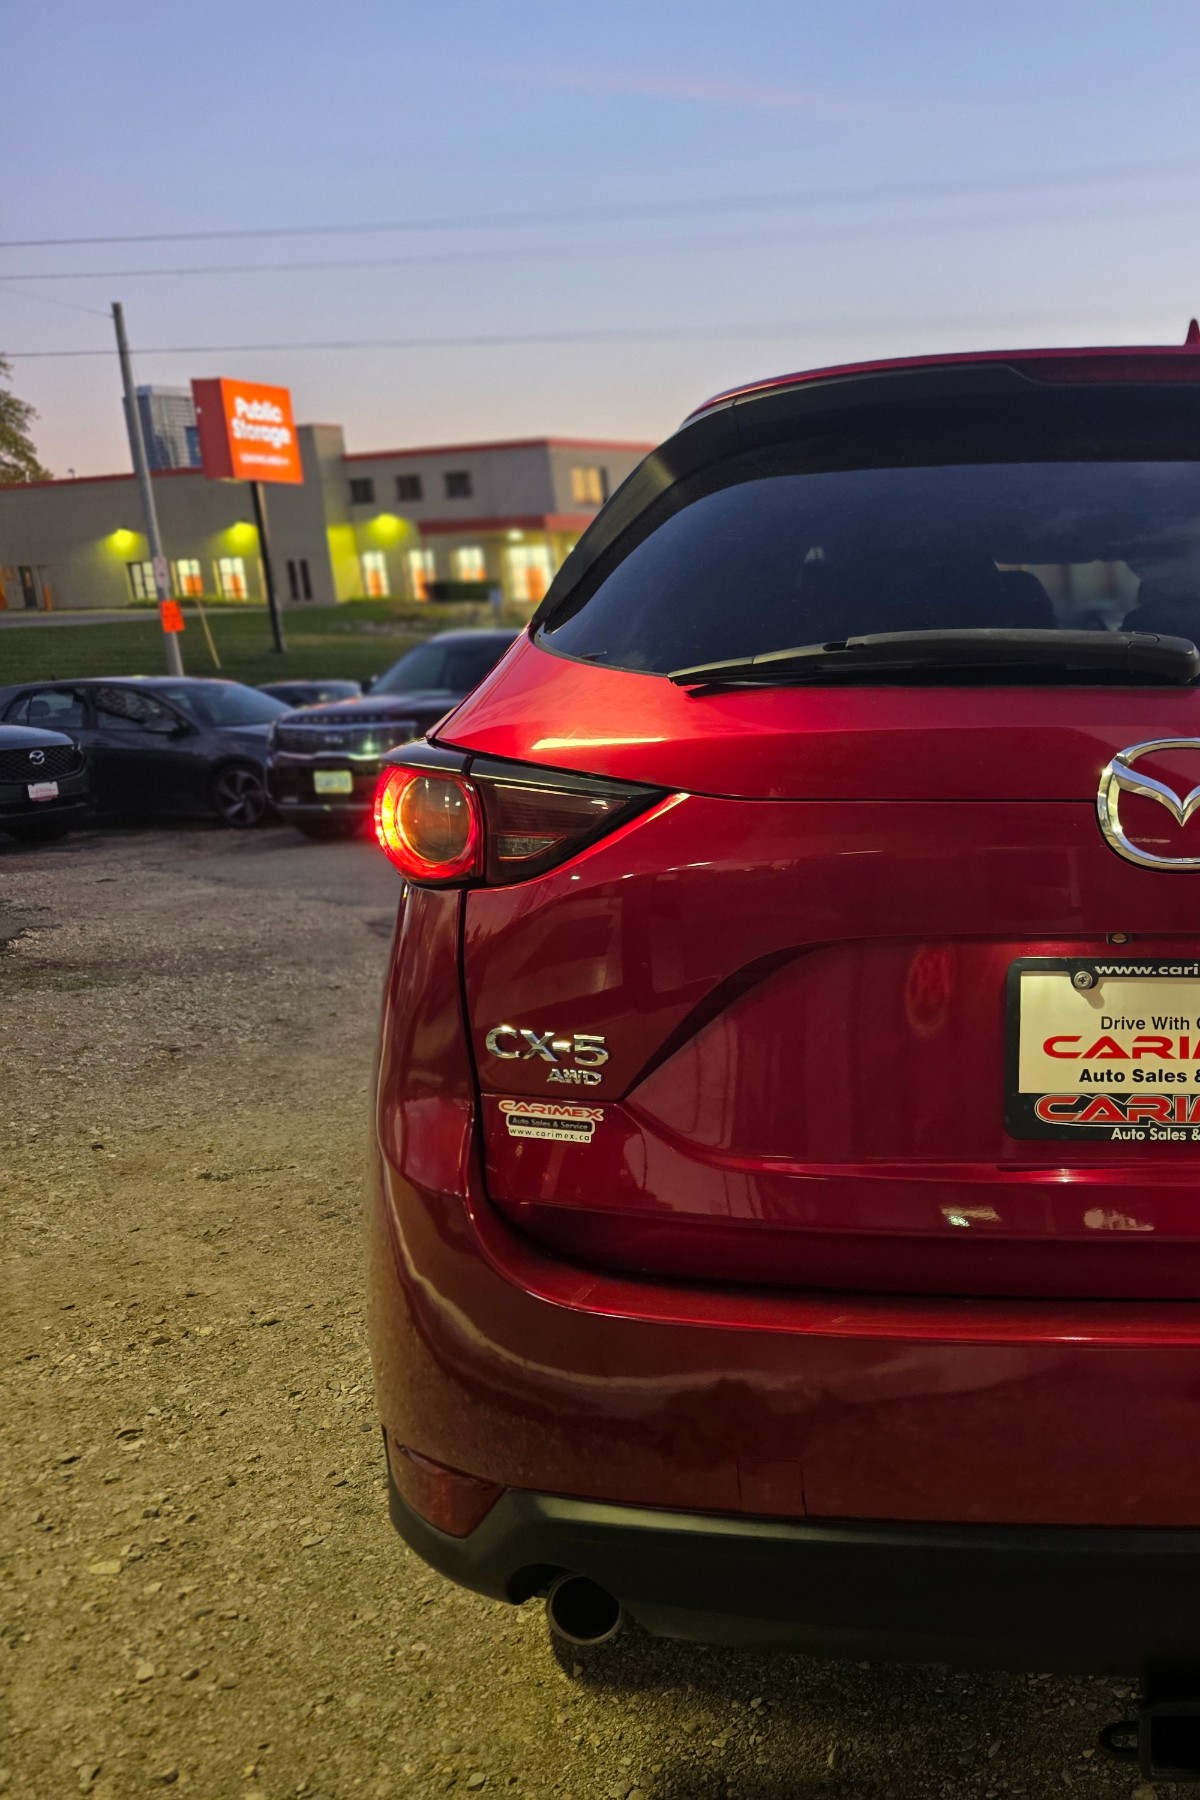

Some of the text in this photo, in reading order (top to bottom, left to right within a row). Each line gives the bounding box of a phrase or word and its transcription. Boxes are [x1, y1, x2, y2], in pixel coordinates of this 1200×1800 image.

[234, 396, 283, 423] Public
[231, 416, 291, 449] Storage
[1100, 1016, 1146, 1031] Drive
[1151, 1016, 1190, 1031] With
[485, 1025, 609, 1067] CX-5
[546, 1069, 602, 1086] AWD
[1079, 1069, 1126, 1084] Auto
[1132, 1069, 1188, 1084] Sales
[499, 1101, 604, 1121] CARIMEX
[512, 1117, 588, 1131] Auto Sales & Service
[510, 1127, 590, 1141] www.carimex.ca
[1111, 1128, 1147, 1141] Auto
[1149, 1128, 1187, 1141] Sales
